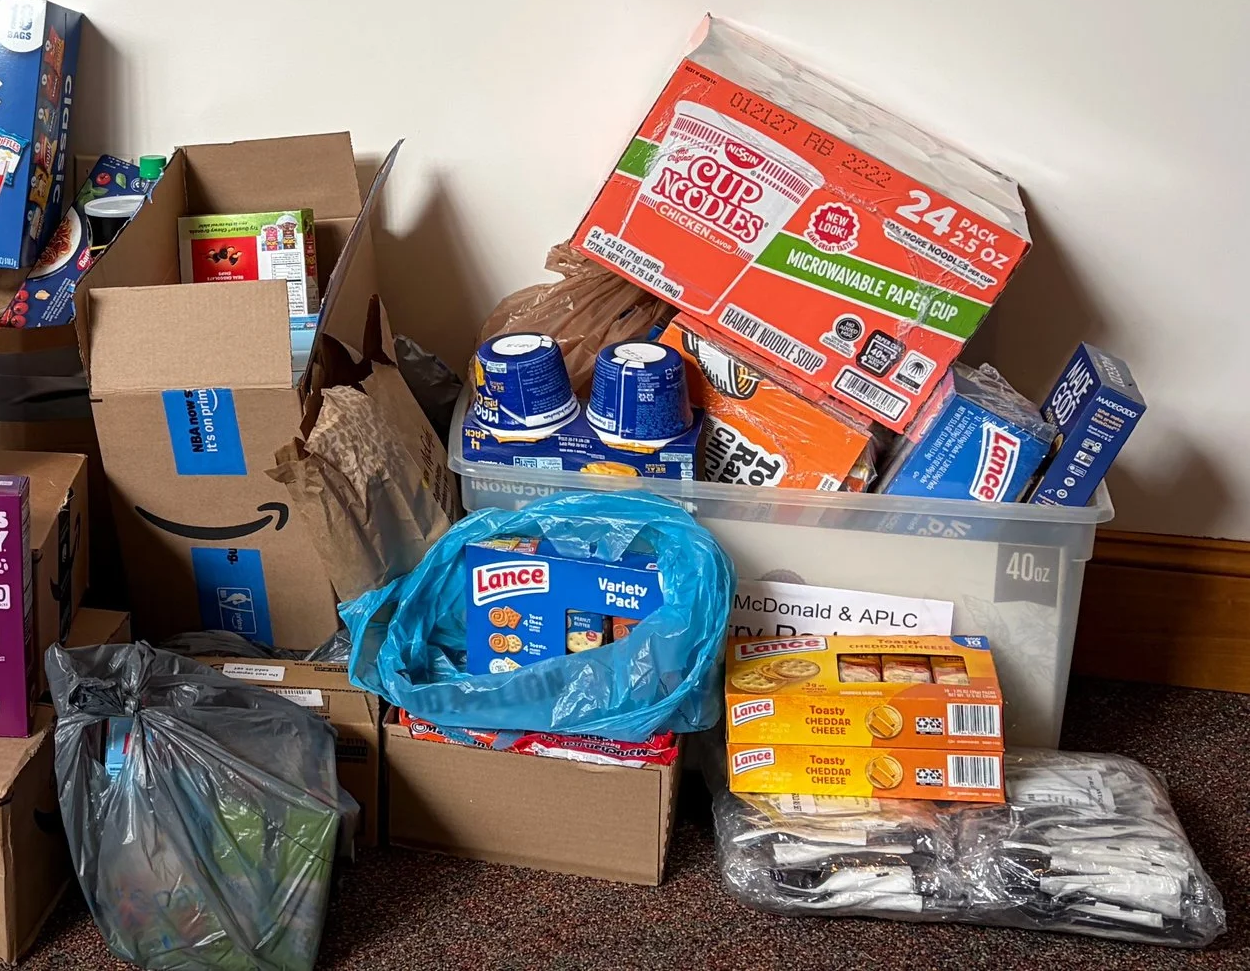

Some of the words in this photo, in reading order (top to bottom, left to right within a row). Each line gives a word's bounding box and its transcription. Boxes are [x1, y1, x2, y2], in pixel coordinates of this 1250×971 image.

[729, 92, 798, 134] 012127
[728, 143, 759, 166] NISSIN
[688, 156, 764, 208] CUP
[651, 167, 765, 244] NOODLES
[658, 205, 711, 240] CHICKEN
[824, 212, 849, 225] NEW
[895, 190, 957, 236] 24
[959, 218, 999, 246] PACK
[818, 221, 848, 239] LOOK!
[950, 231, 980, 255] 2.5
[980, 248, 1010, 270] OZ
[786, 249, 886, 297] MICROWAVABLE
[885, 284, 928, 311] PAPER
[931, 300, 958, 322] CUP
[722, 311, 757, 342] RAMEN
[758, 328, 794, 362] NOODLE
[792, 350, 824, 373] SOUP
[189, 406, 201, 427] now
[1096, 394, 1137, 419] MADEGOOD
[192, 429, 205, 453] NBA
[977, 432, 1018, 502] Lance
[1006, 552, 1034, 580] 40
[476, 567, 545, 593] Lance
[598, 576, 648, 598] Variety
[605, 592, 639, 610] Pack
[734, 593, 831, 620] McDonald
[839, 608, 852, 621] &
[859, 609, 918, 629] APLC
[740, 637, 822, 659] Lance
[734, 701, 771, 721] Lance
[805, 717, 851, 726] CHEDDAR
[809, 705, 845, 717] Toasty
[811, 726, 847, 736] CHEESE
[734, 751, 772, 769] Lance
[805, 767, 851, 776] CHEDDAR
[810, 755, 846, 766] Toasty
[811, 775, 847, 786] CHEESE
